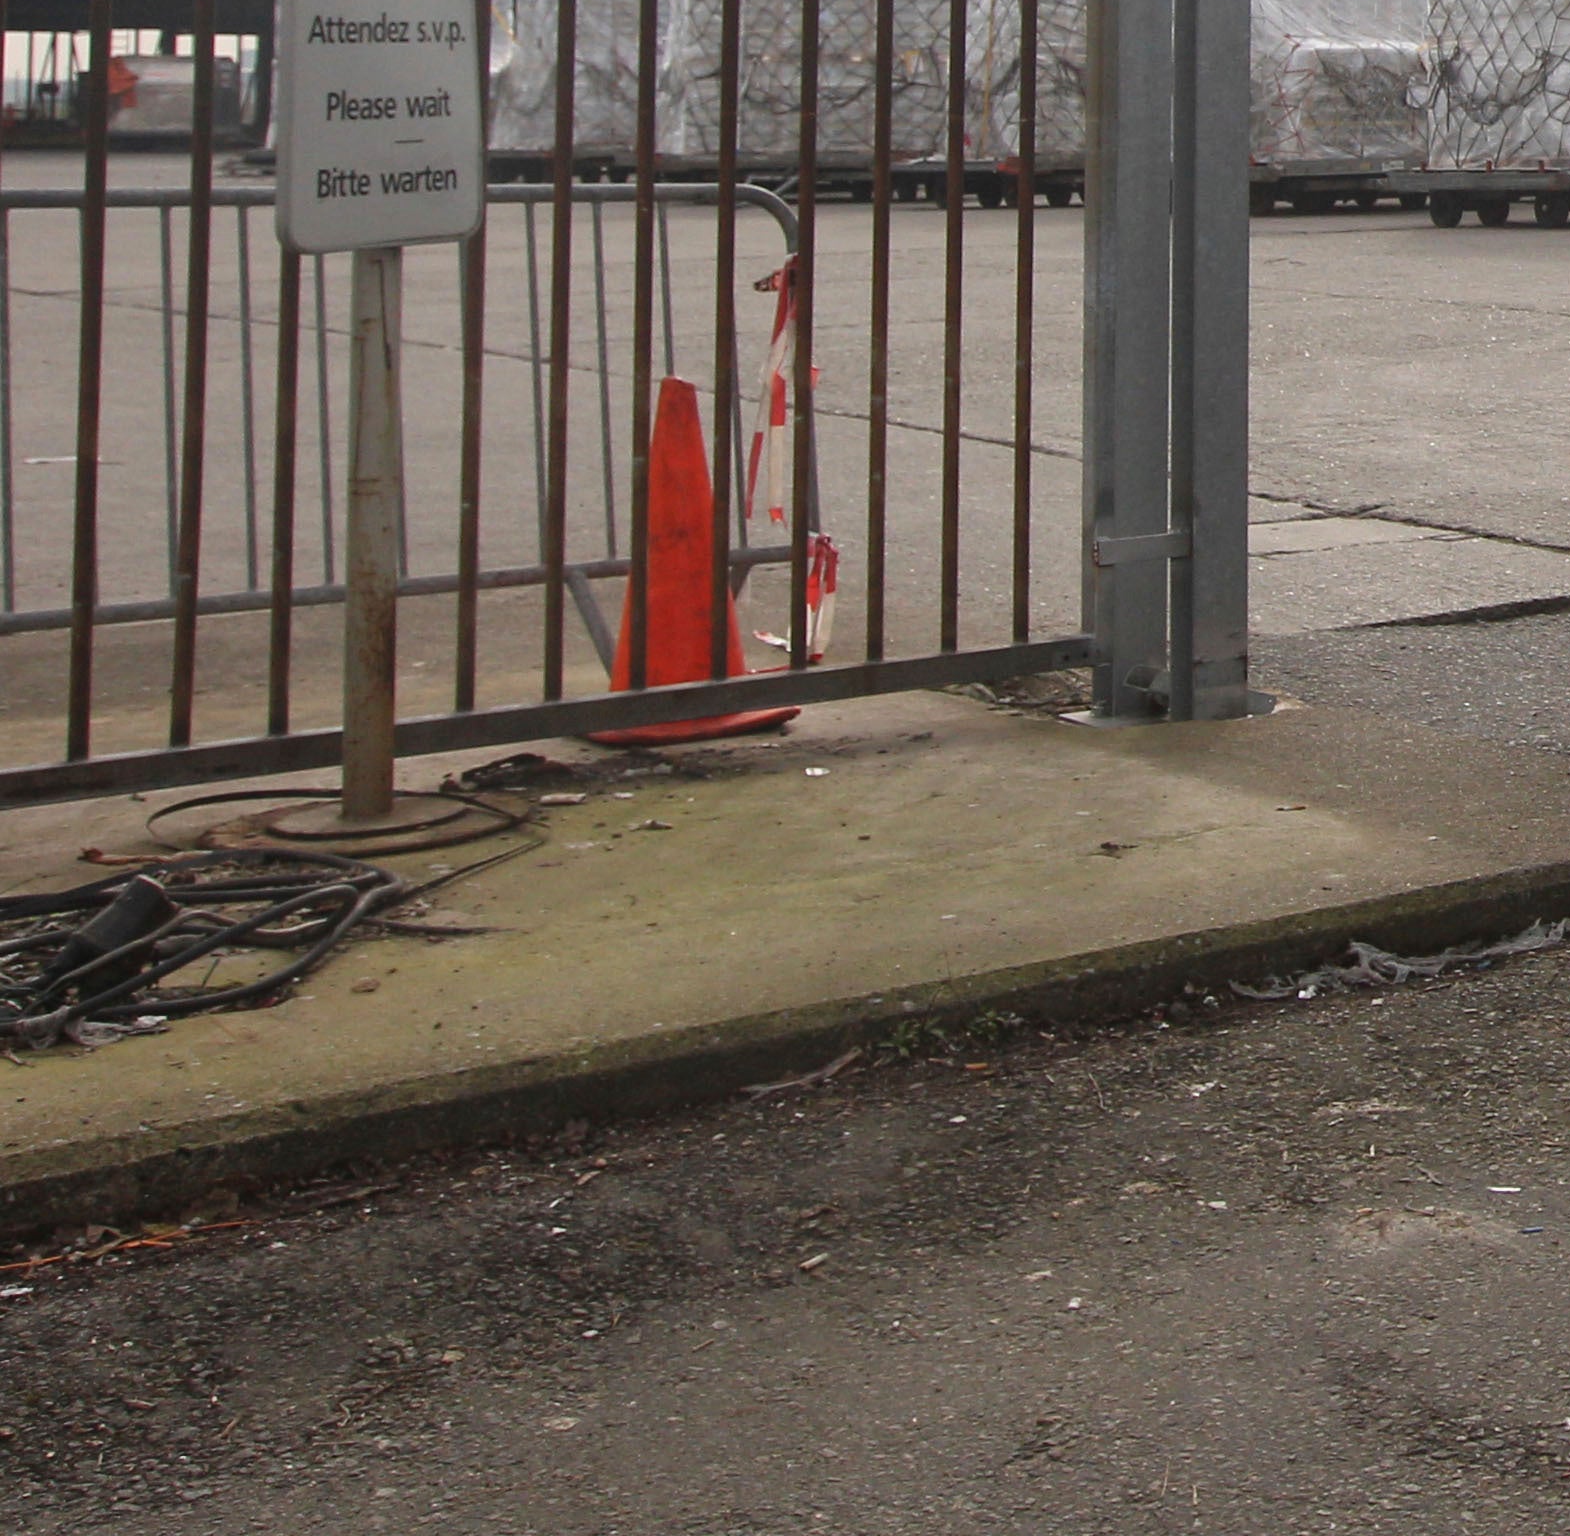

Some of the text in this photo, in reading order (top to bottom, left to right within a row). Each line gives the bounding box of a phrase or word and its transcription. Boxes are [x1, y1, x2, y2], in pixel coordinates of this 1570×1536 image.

[307, 13, 466, 50] Attendez s.v.p.
[326, 88, 451, 120] Please wait
[316, 166, 457, 199] Bitte warten
